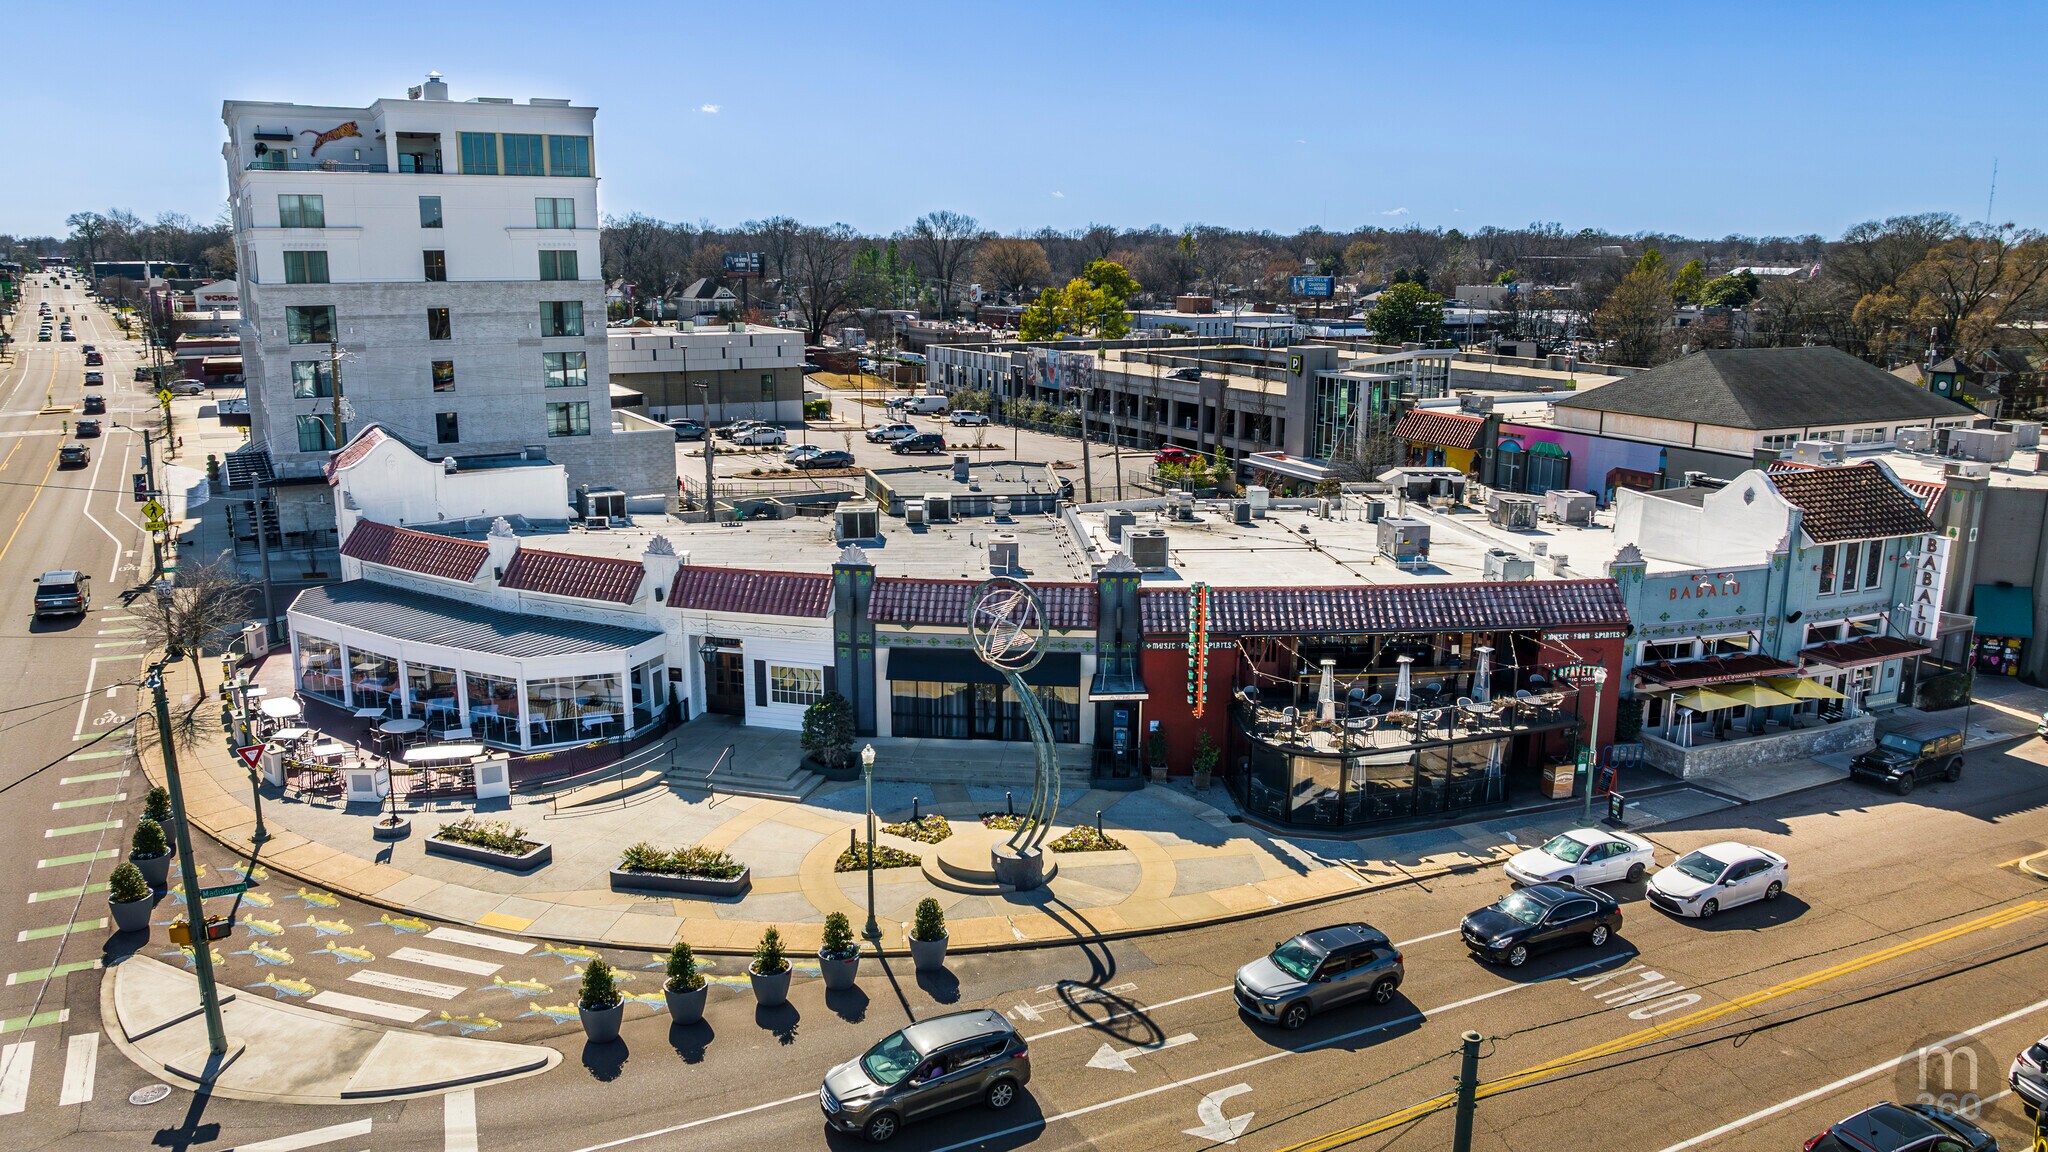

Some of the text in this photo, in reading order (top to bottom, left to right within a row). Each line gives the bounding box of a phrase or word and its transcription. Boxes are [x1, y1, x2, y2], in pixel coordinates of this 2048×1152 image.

[1669, 581, 1741, 601] BABALU
[1914, 537, 1938, 637] BABALU
[1548, 631, 1620, 641] MUSIC FOOD SPIRITS
[1152, 641, 1176, 650] MUSIC
[1551, 665, 1604, 681] LAFAYETT
[202, 887, 234, 898] Madison
[1568, 964, 1702, 1020] ONLY
